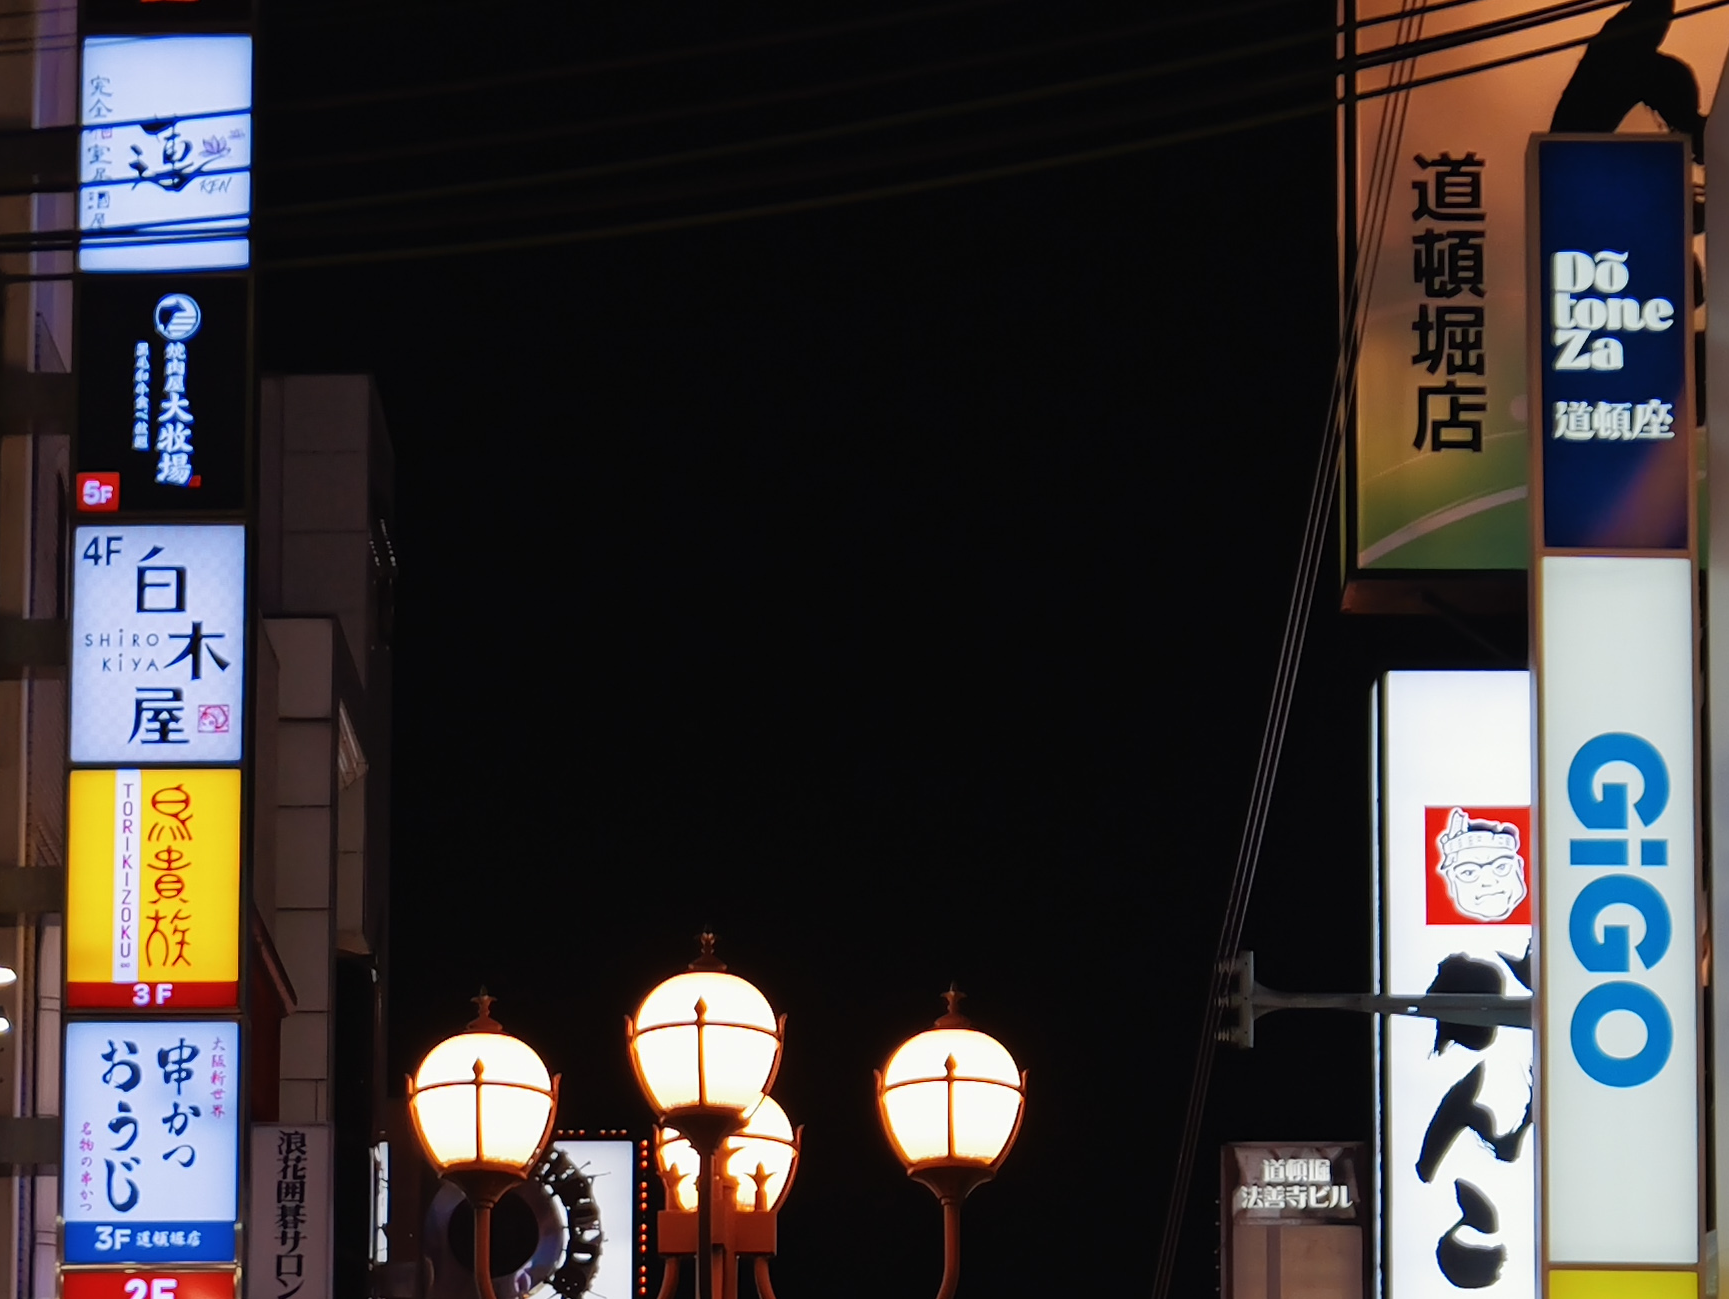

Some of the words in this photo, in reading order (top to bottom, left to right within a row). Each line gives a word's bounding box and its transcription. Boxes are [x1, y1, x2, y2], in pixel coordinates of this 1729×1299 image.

[1411, 151, 1487, 454] 道頓堀店
[1553, 295, 1675, 332] tone
[1552, 328, 1625, 371] Za
[1553, 398, 1675, 441] 道頓座
[82, 480, 113, 504] 5F
[81, 534, 123, 567] 4F
[128, 545, 230, 745] 白木屋
[121, 782, 133, 959] TORIKIZOKU
[145, 783, 194, 967] 鳥貴族
[1568, 731, 1672, 1088] GiGO
[132, 984, 173, 1005] 3F
[157, 1037, 201, 1169] 串かつ
[210, 1036, 227, 1118] 大阪新世界
[79, 1120, 94, 1211] 名物の串かつ
[101, 1038, 142, 1212] おうじ
[94, 1225, 131, 1250] 3F
[136, 1230, 201, 1248] 道頓堀店
[1241, 1186, 1352, 1210] 法善寺ビル
